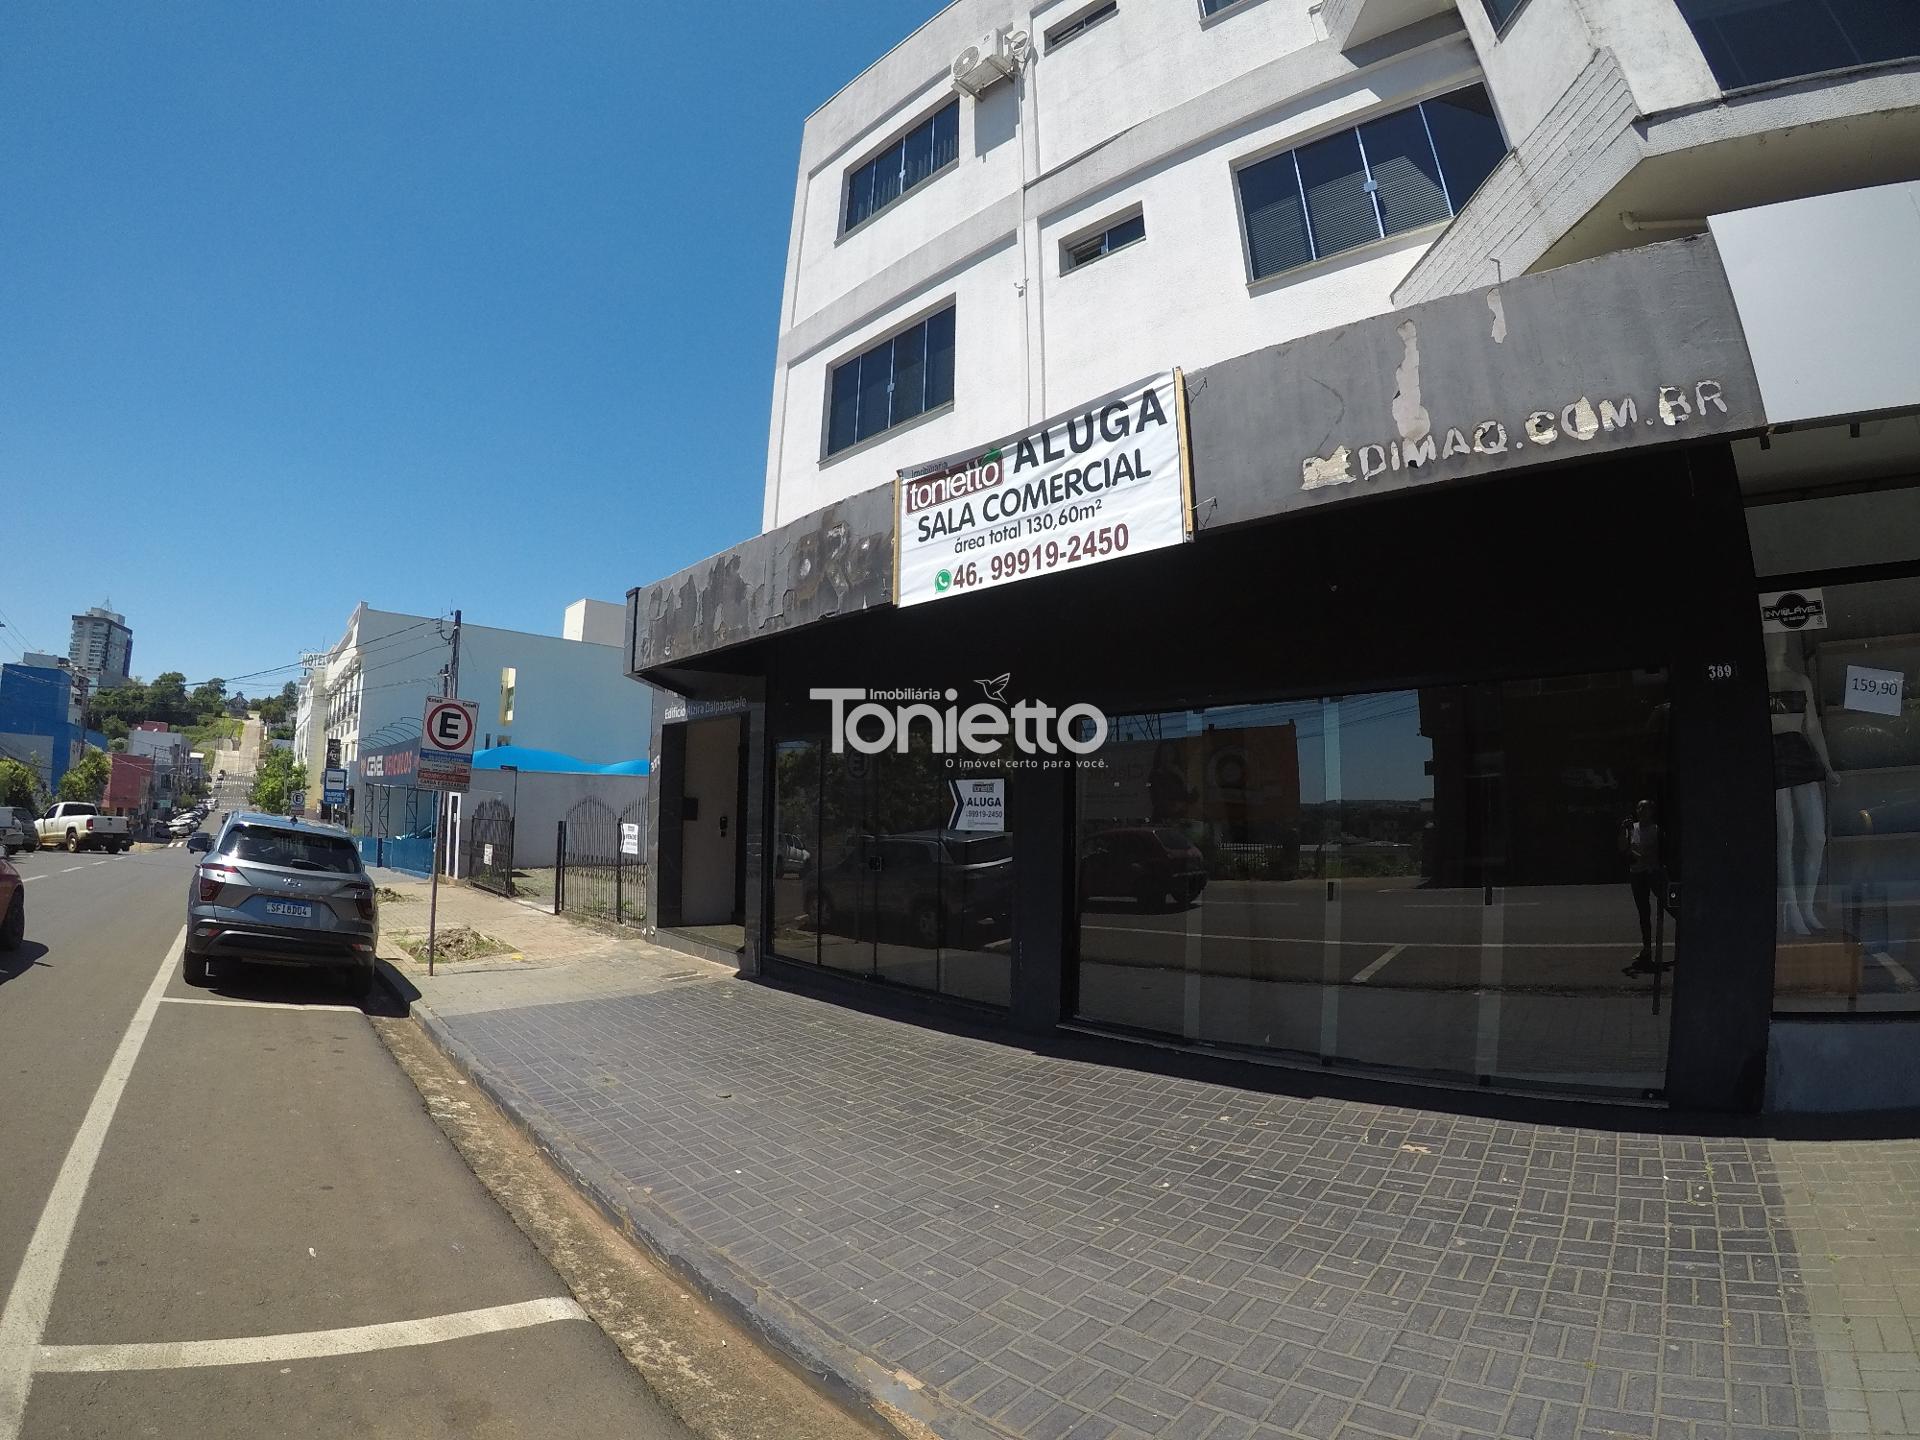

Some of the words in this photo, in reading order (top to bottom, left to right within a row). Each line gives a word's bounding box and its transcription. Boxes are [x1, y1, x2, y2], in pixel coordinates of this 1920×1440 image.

[1013, 388, 1167, 473] ALUGA
[918, 502, 976, 543] SALA
[982, 448, 1152, 522] COMERCIAL
[954, 536, 985, 554] área
[989, 520, 1021, 545] total
[1027, 498, 1103, 535] 130,60m²
[953, 562, 983, 588] 46.
[991, 523, 1129, 581] 99919-2450
[1708, 664, 1732, 679] 389
[1852, 677, 1898, 696] 159,90
[439, 711, 461, 739] E
[966, 797, 1002, 807] ALUGA
